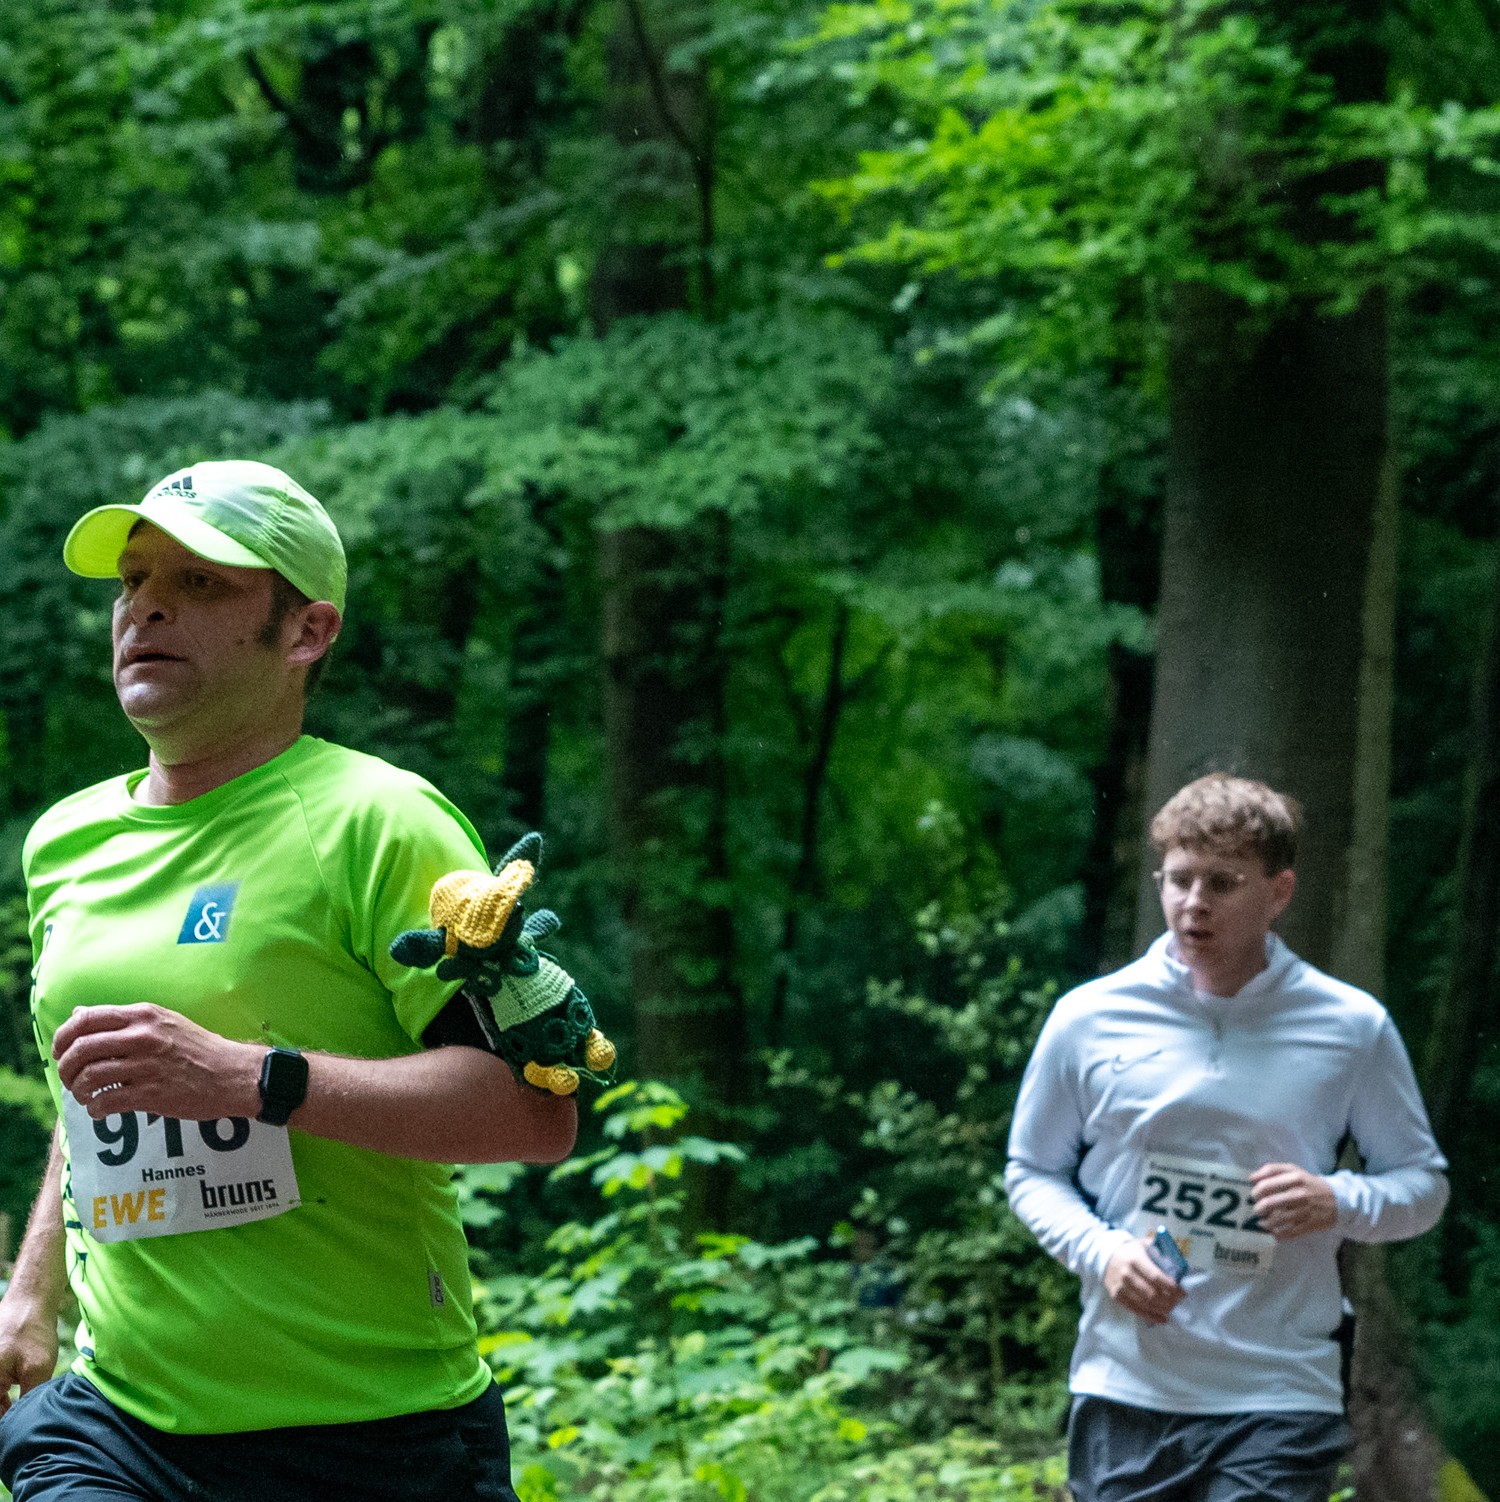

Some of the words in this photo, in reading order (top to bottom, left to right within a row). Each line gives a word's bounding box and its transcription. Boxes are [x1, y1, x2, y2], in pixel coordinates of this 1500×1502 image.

[142, 1164, 206, 1182] Hannes
[93, 1188, 166, 1229] EWE
[200, 1179, 277, 1209] bruns
